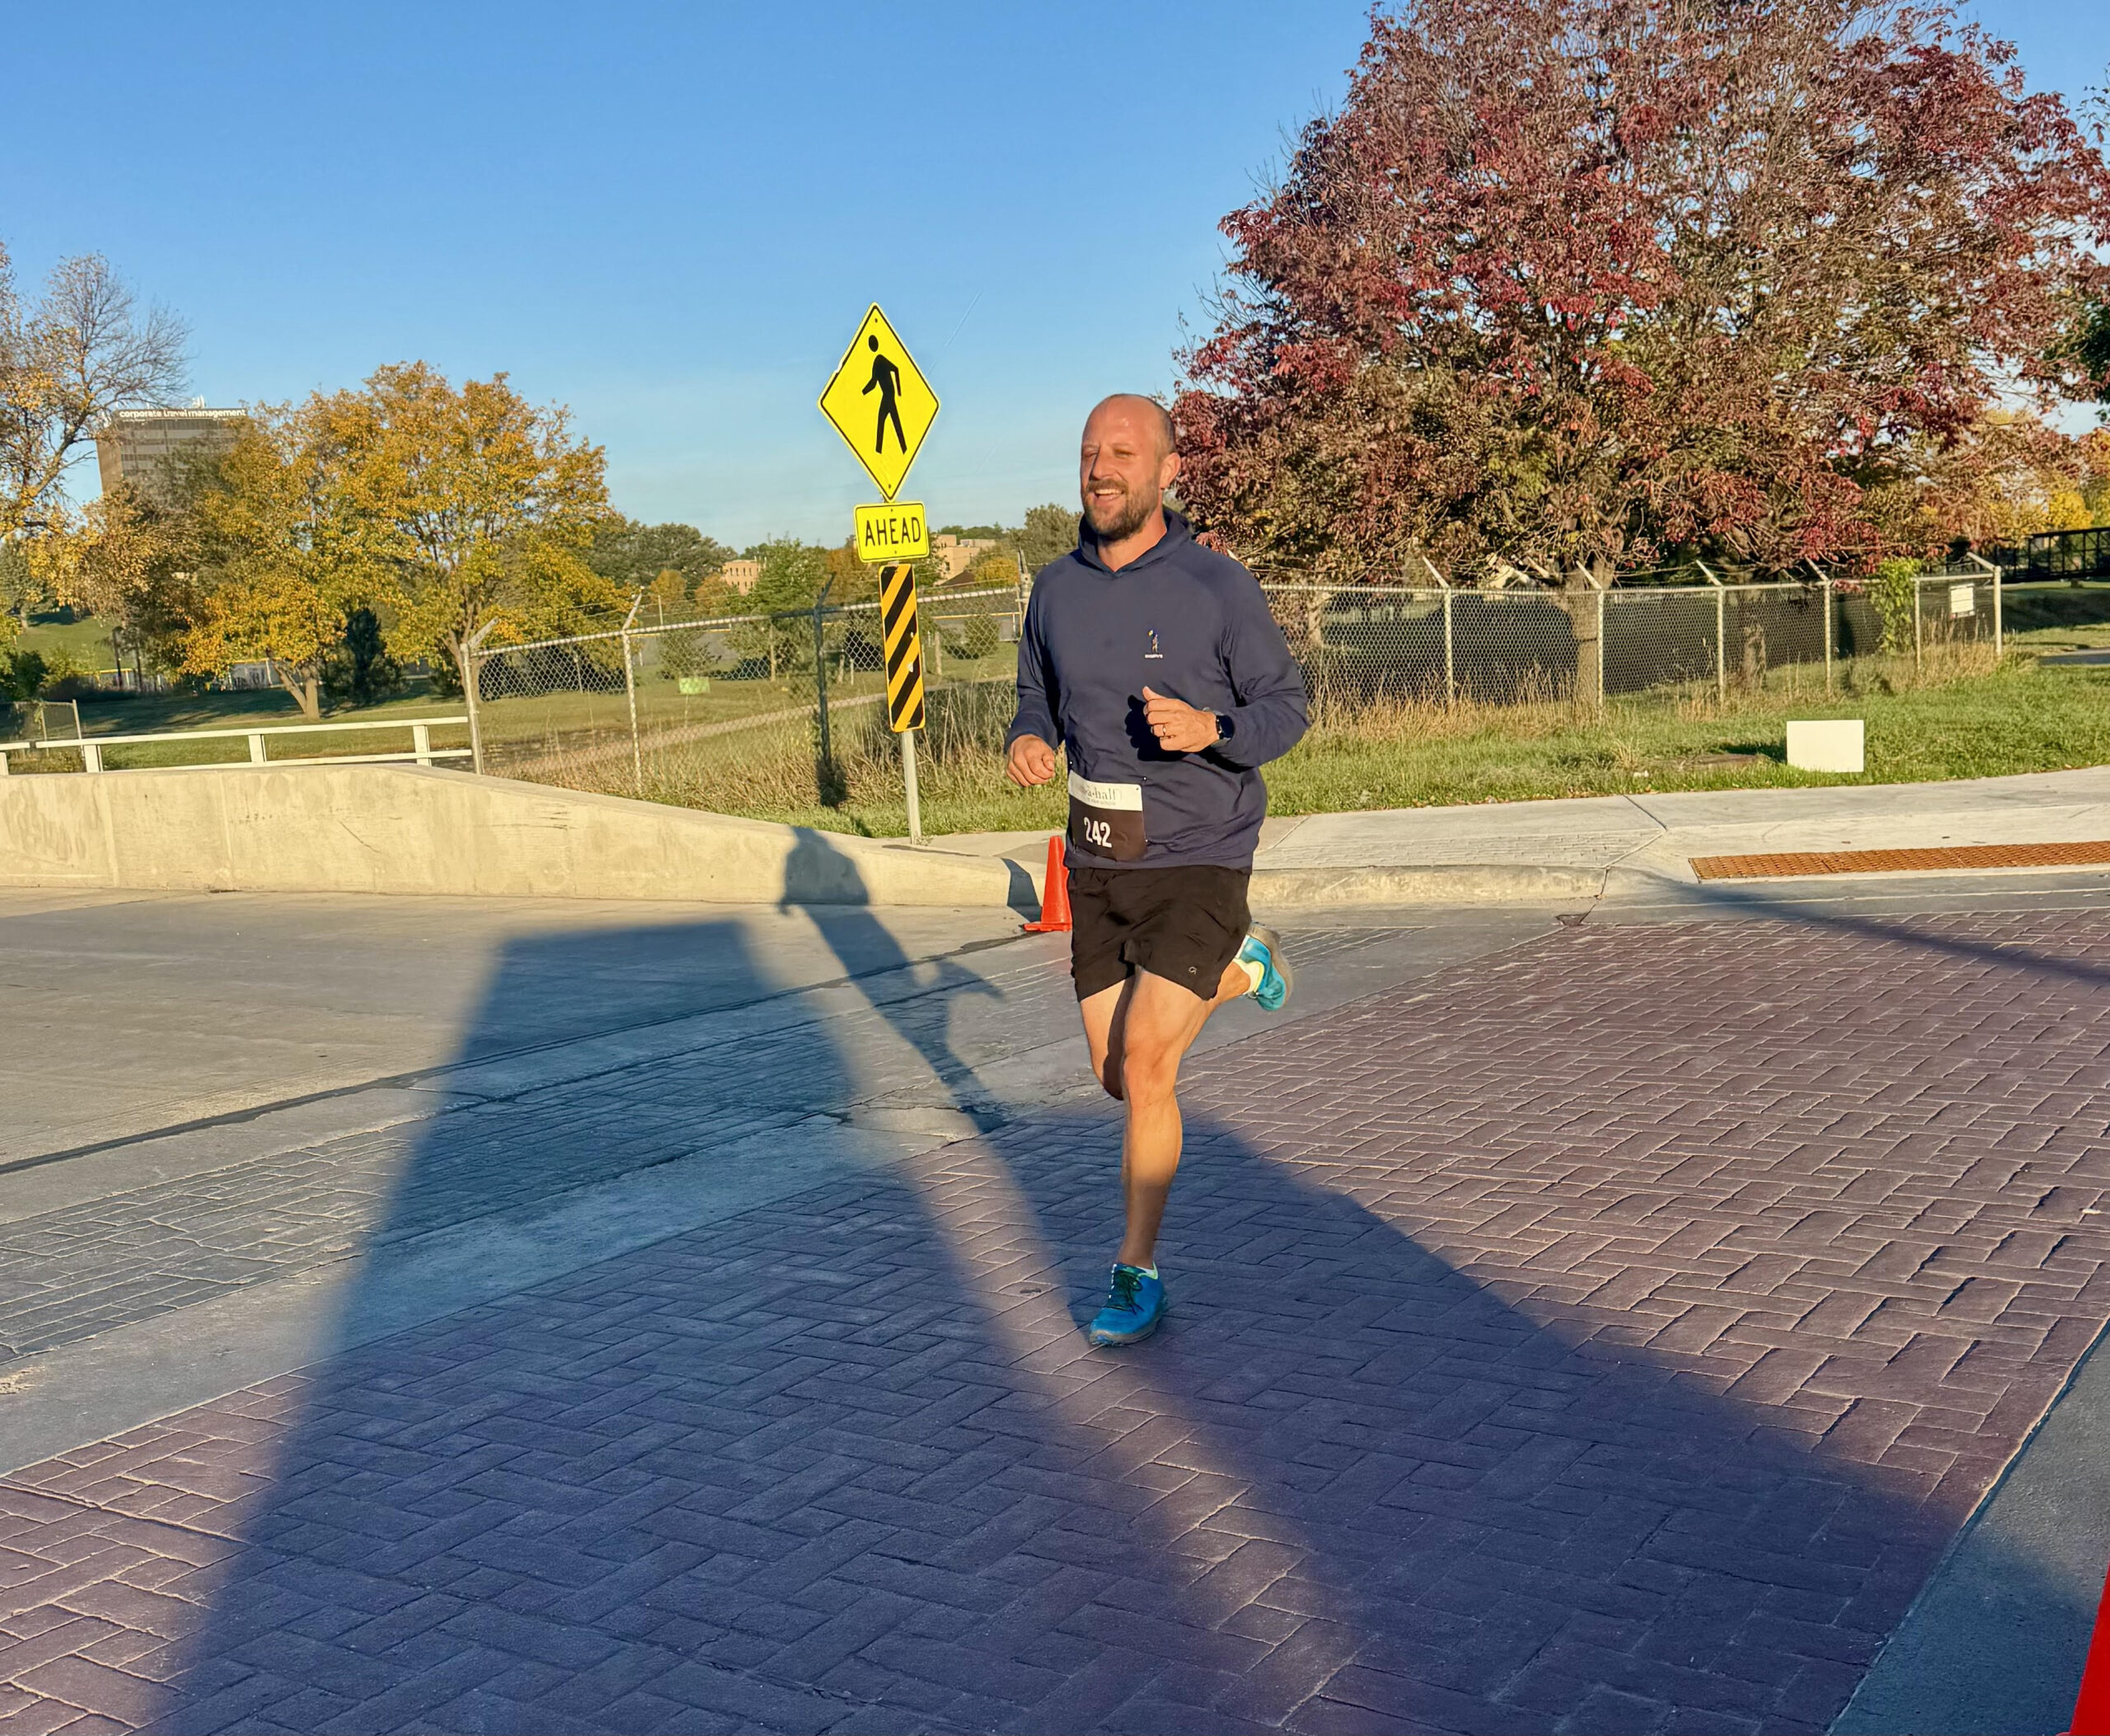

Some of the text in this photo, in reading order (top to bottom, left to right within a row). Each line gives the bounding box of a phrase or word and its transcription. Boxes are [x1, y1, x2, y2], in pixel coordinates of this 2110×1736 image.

[188, 410, 246, 419] management
[865, 517, 921, 547] AHEAD
[1084, 816, 1113, 848] 242
